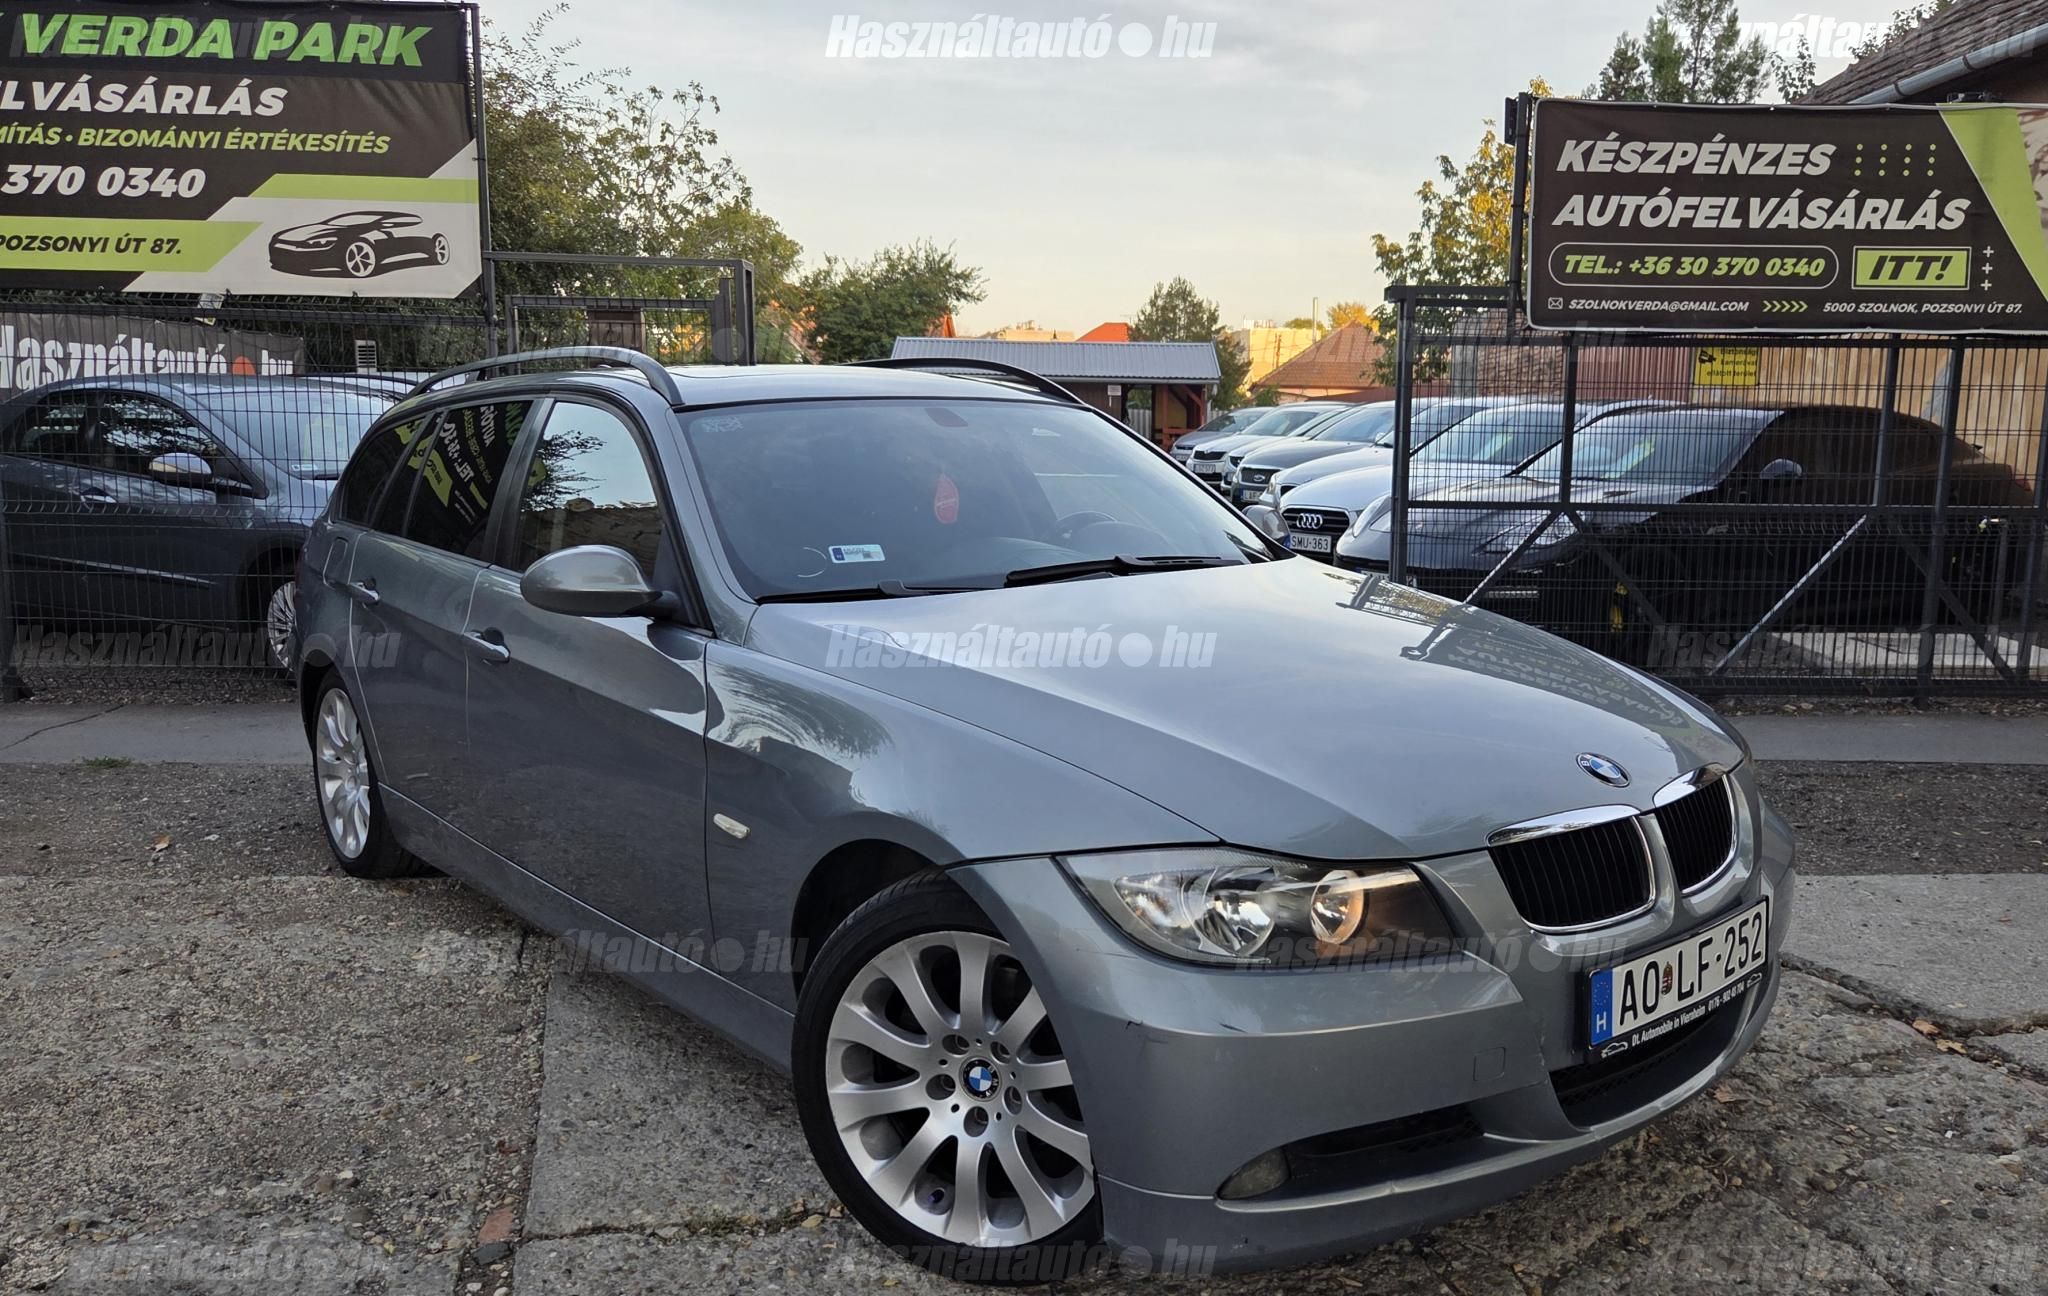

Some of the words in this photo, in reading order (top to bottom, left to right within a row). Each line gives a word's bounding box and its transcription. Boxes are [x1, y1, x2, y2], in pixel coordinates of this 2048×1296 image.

[22, 13, 234, 59] VERDA
[253, 20, 432, 66] PARK
[0, 73, 288, 117] LVÁSÁRLÁS
[78, 126, 219, 149] BIZOMÁNYI
[224, 128, 391, 153] ÉRTÉKESÍTÉS
[1556, 132, 1837, 176] KÉSZPÉNZES
[0, 164, 86, 196] 370
[97, 167, 206, 198] 0340
[1551, 186, 1972, 231] AUTÓFELVÁSÁRLÁS
[115, 233, 146, 253] ÚT
[150, 238, 181, 254] 87.
[1564, 255, 1622, 274] TEL.:
[1629, 256, 1673, 275] +36
[1676, 257, 1709, 275] 30
[1712, 257, 1760, 276] 370
[1764, 258, 1825, 277] 0340
[1869, 255, 1954, 281] ITT!
[1568, 299, 1749, 312] SZOLNOKVERDA@GMAIL.COM
[1823, 302, 1856, 313] 5000
[1857, 302, 1918, 314] SZOLNOK,
[1921, 303, 1985, 313] POZSONYI
[1987, 301, 2002, 313] ÚT
[2005, 304, 2022, 313] 87.
[1291, 535, 1329, 550] SMU-363
[1620, 961, 1660, 1027] AO
[1596, 1012, 1607, 1034] H
[1641, 1019, 1674, 1042] Automobile
[1674, 1016, 1680, 1028] in
